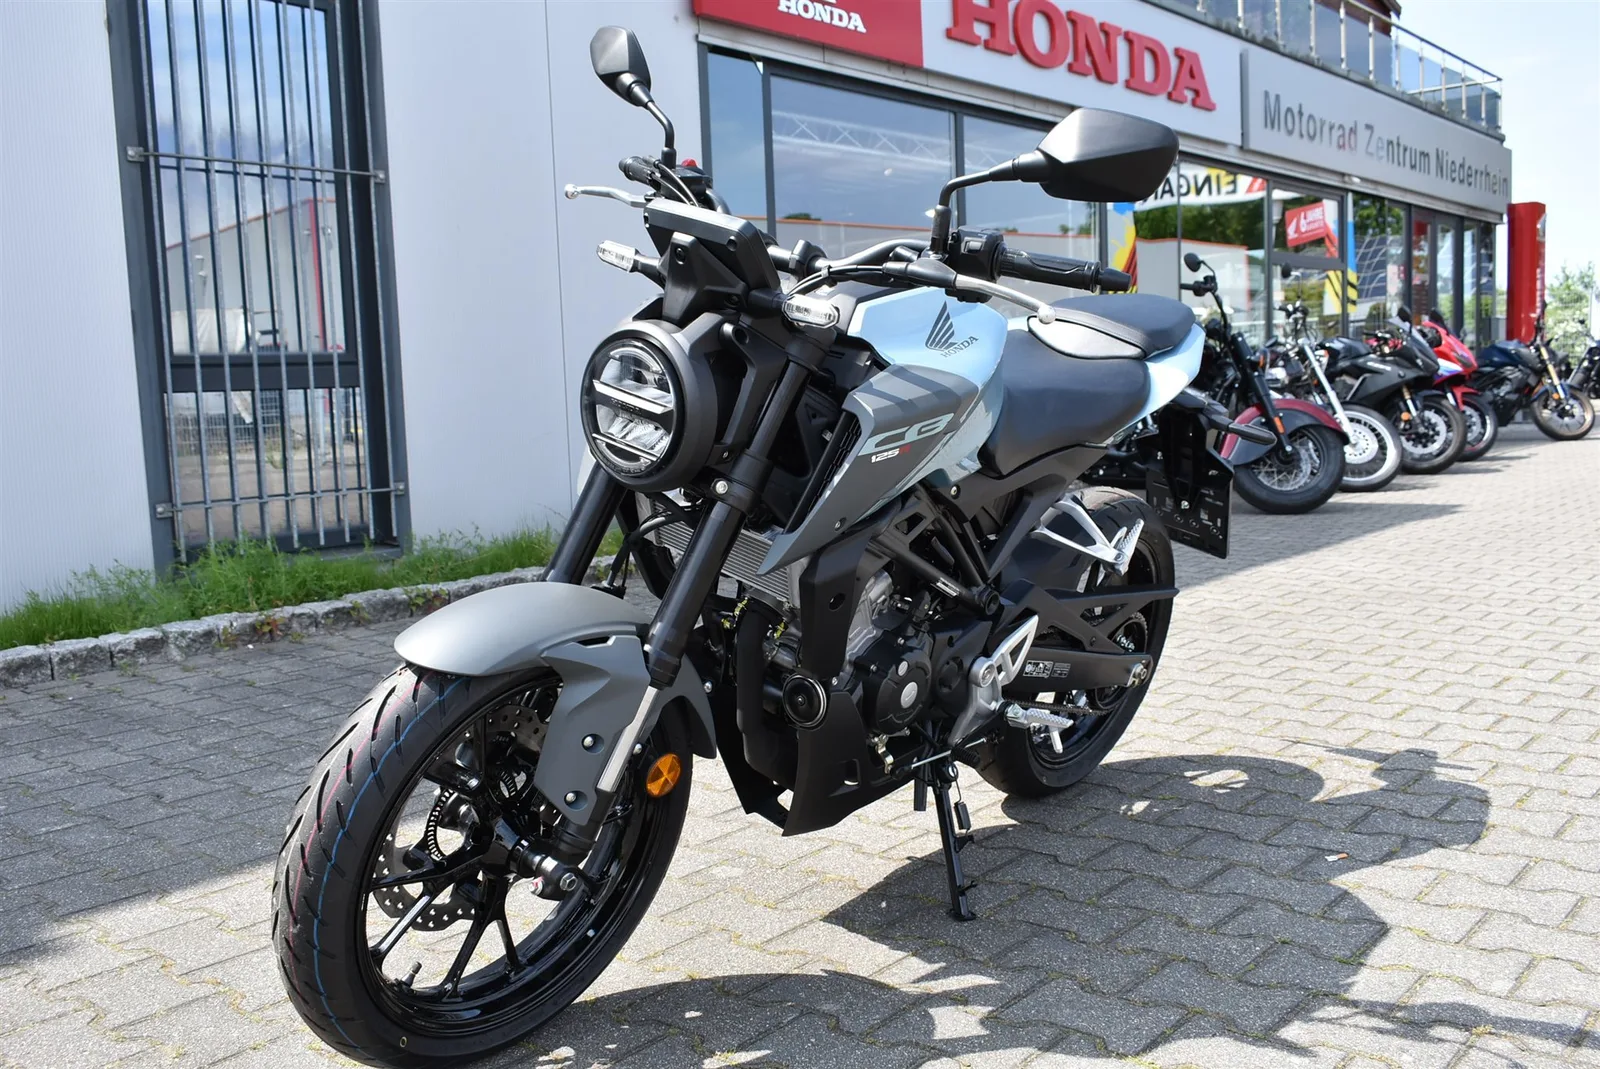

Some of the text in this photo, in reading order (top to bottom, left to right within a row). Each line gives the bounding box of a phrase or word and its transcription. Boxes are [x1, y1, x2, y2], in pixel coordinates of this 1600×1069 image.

[777, 0, 867, 33] HONDA
[946, 0, 1216, 112] HONDA
[1263, 89, 1509, 197] Motorrad Zentrum Niederrhein
[940, 335, 979, 358] HONDA
[858, 413, 954, 456] CB
